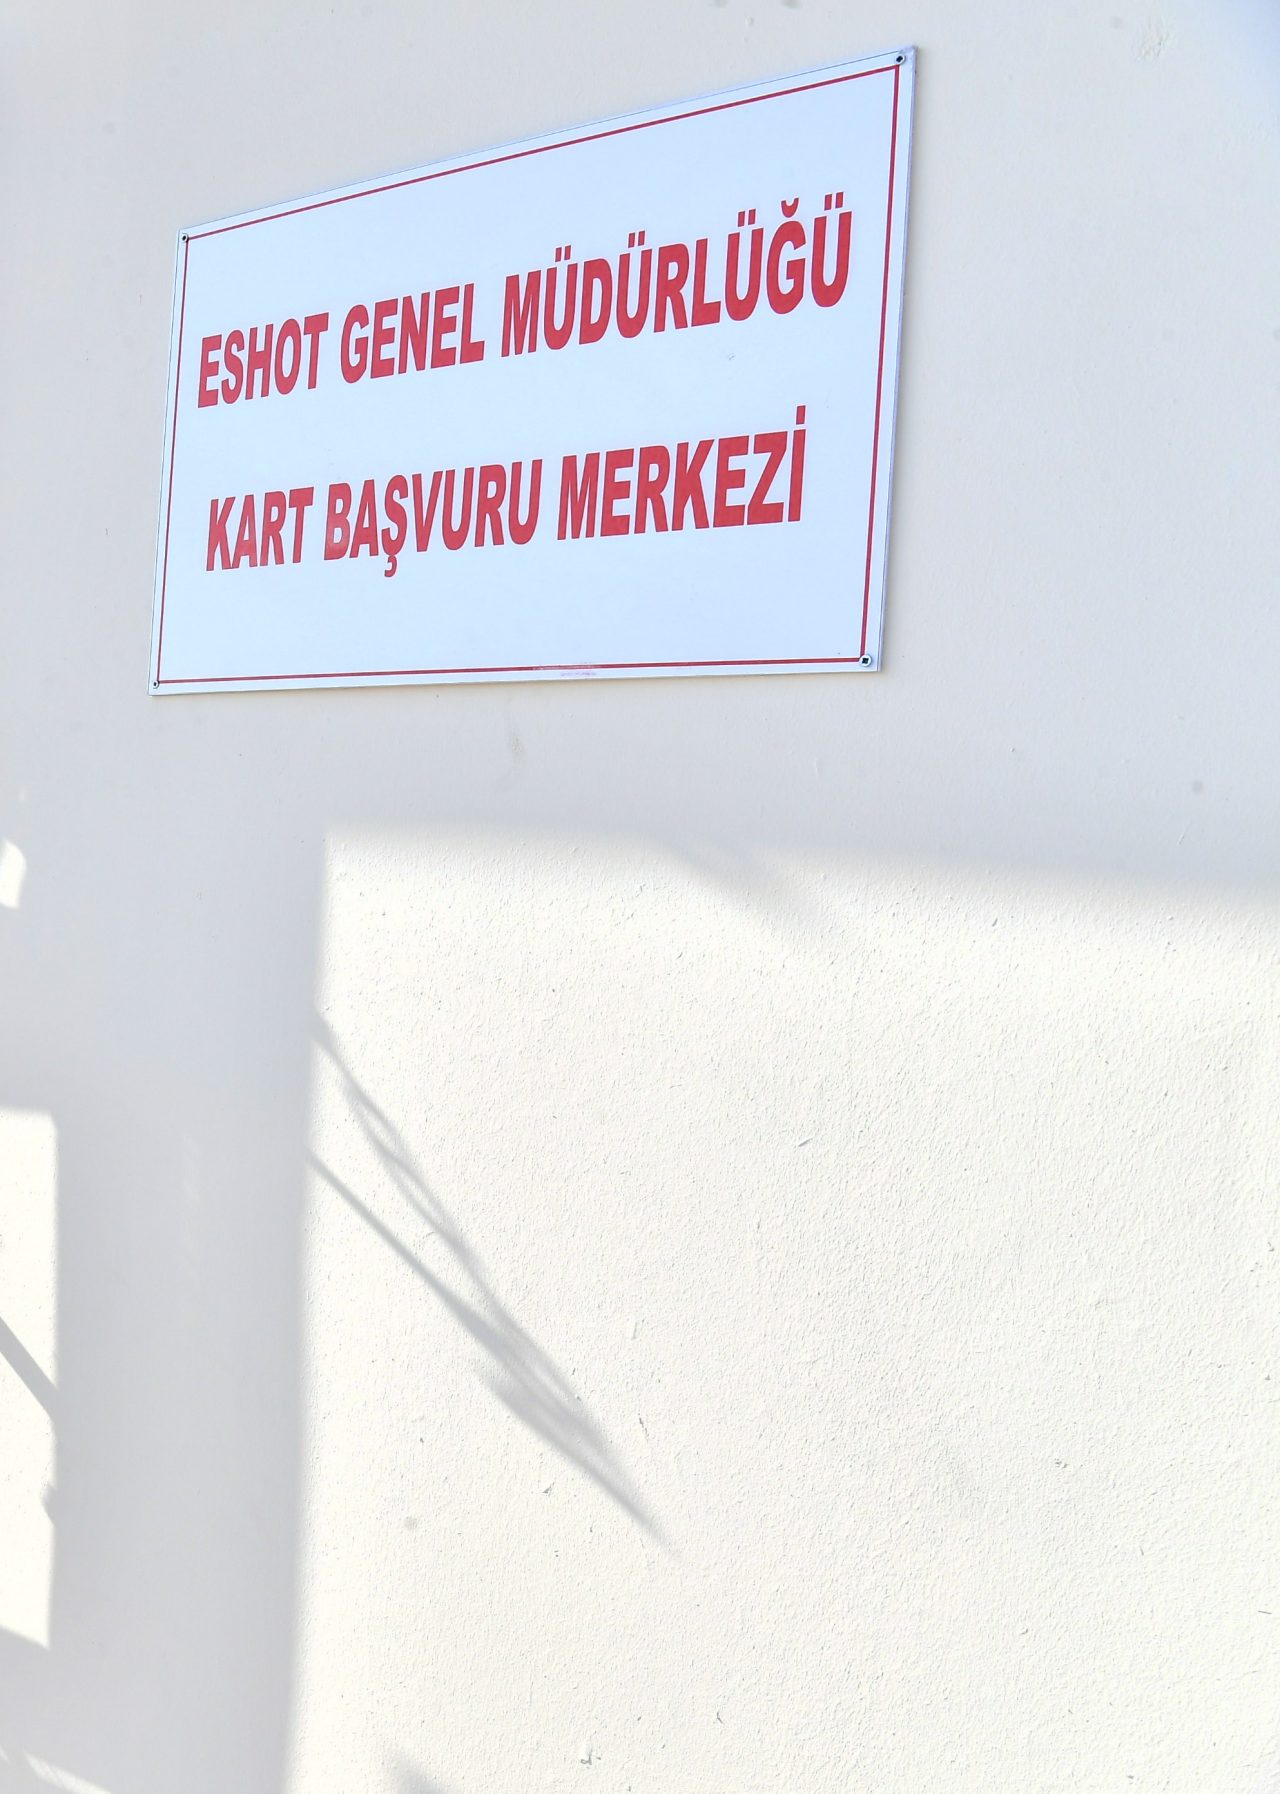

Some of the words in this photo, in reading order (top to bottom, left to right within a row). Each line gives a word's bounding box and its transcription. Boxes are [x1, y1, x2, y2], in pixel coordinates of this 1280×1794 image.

[198, 312, 329, 408] ESHOT
[340, 283, 485, 384] GENEL
[501, 191, 852, 357] MÜDÜRLÜĞÜ
[206, 487, 314, 571] KART
[324, 459, 543, 577] BAŞVURU
[557, 405, 806, 540] MERKEZİ
